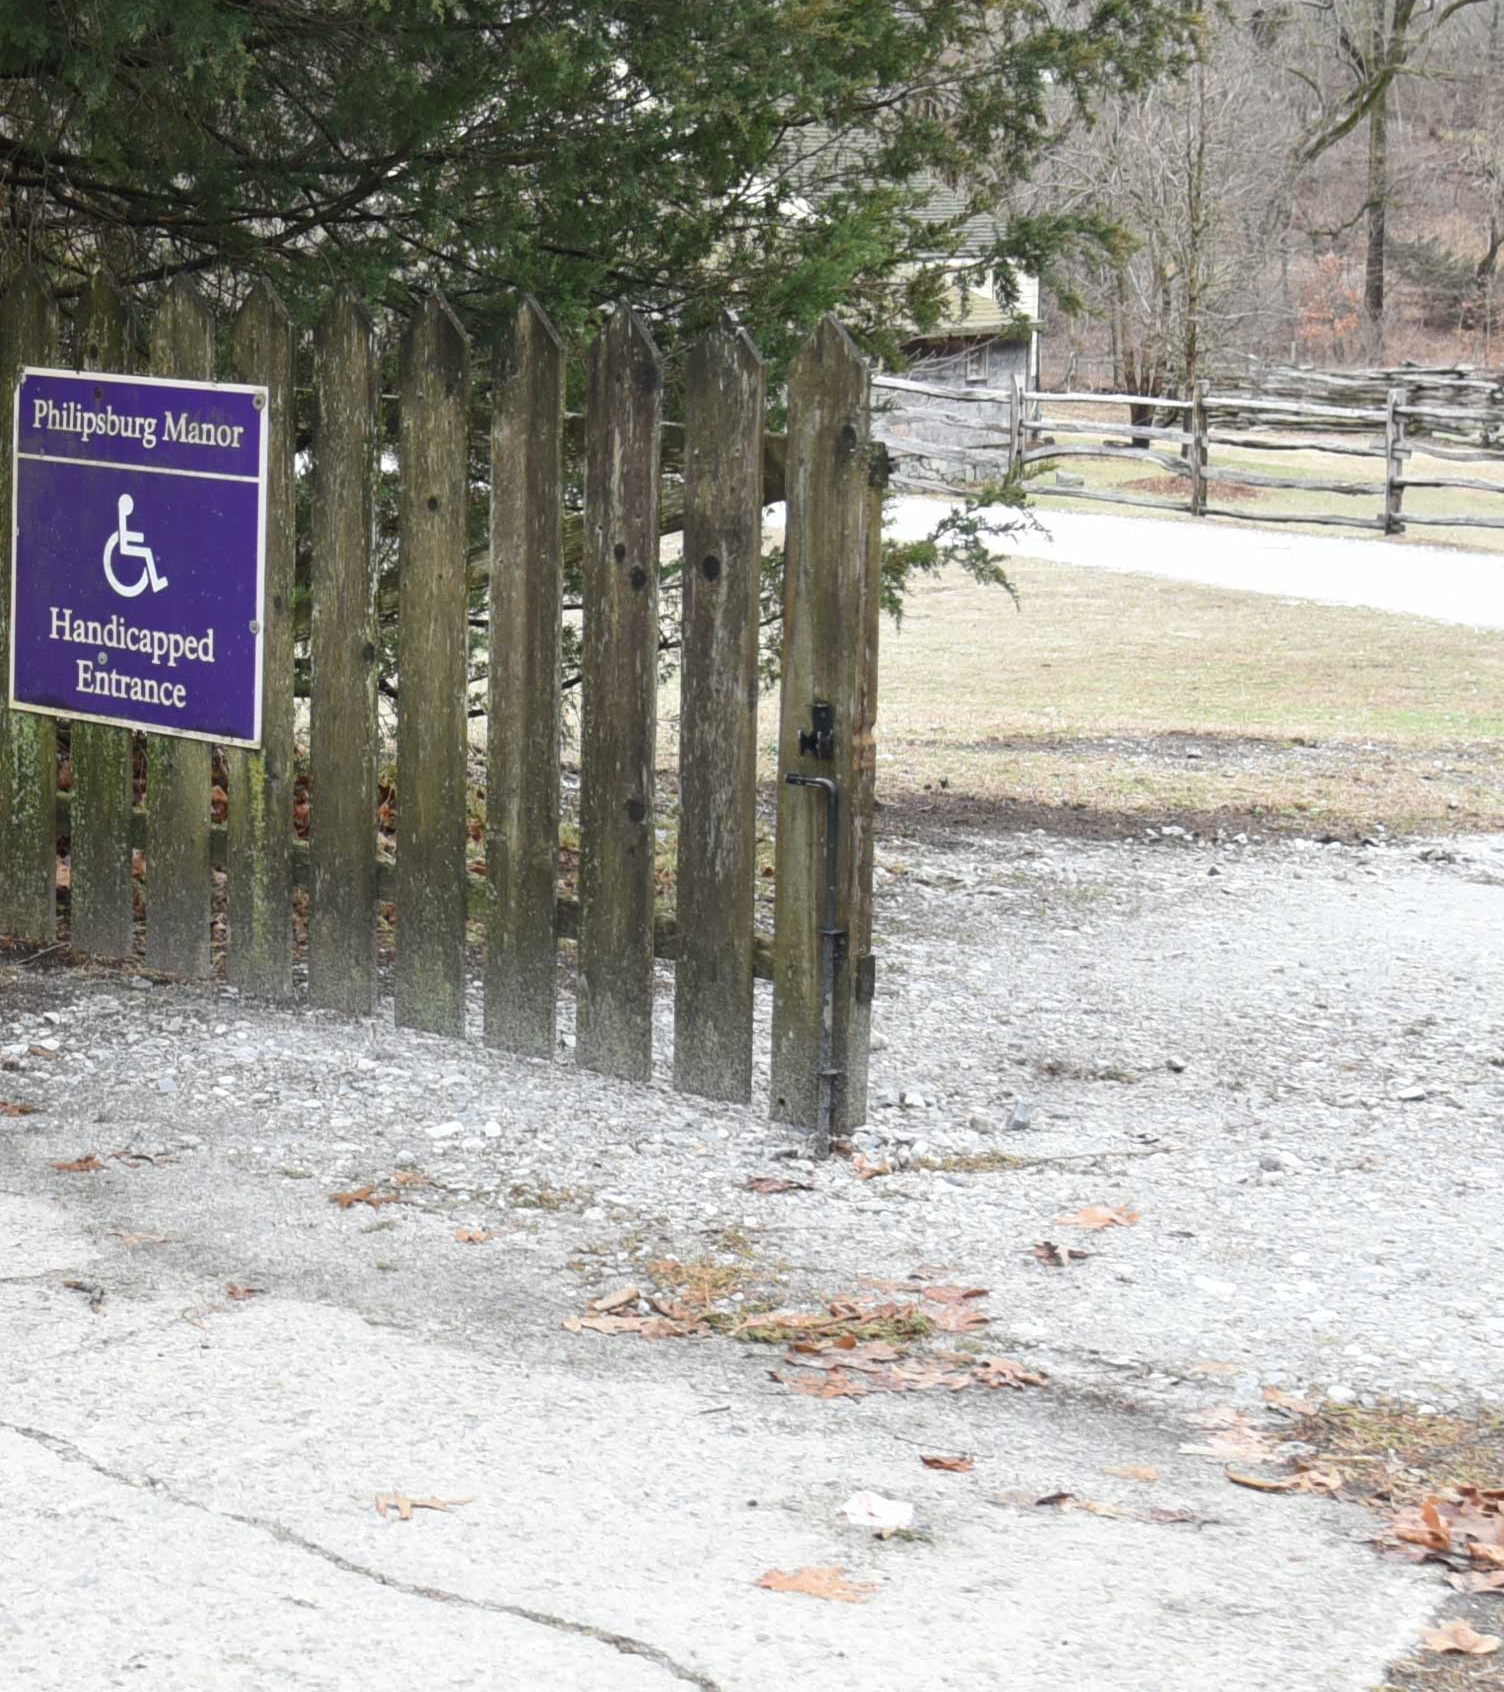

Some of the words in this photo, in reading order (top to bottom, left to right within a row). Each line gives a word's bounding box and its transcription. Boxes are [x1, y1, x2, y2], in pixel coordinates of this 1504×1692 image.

[32, 398, 157, 449] Philipsburg
[162, 410, 244, 448] Manor
[49, 607, 215, 667] Handicapped
[75, 659, 187, 708] Entrance
